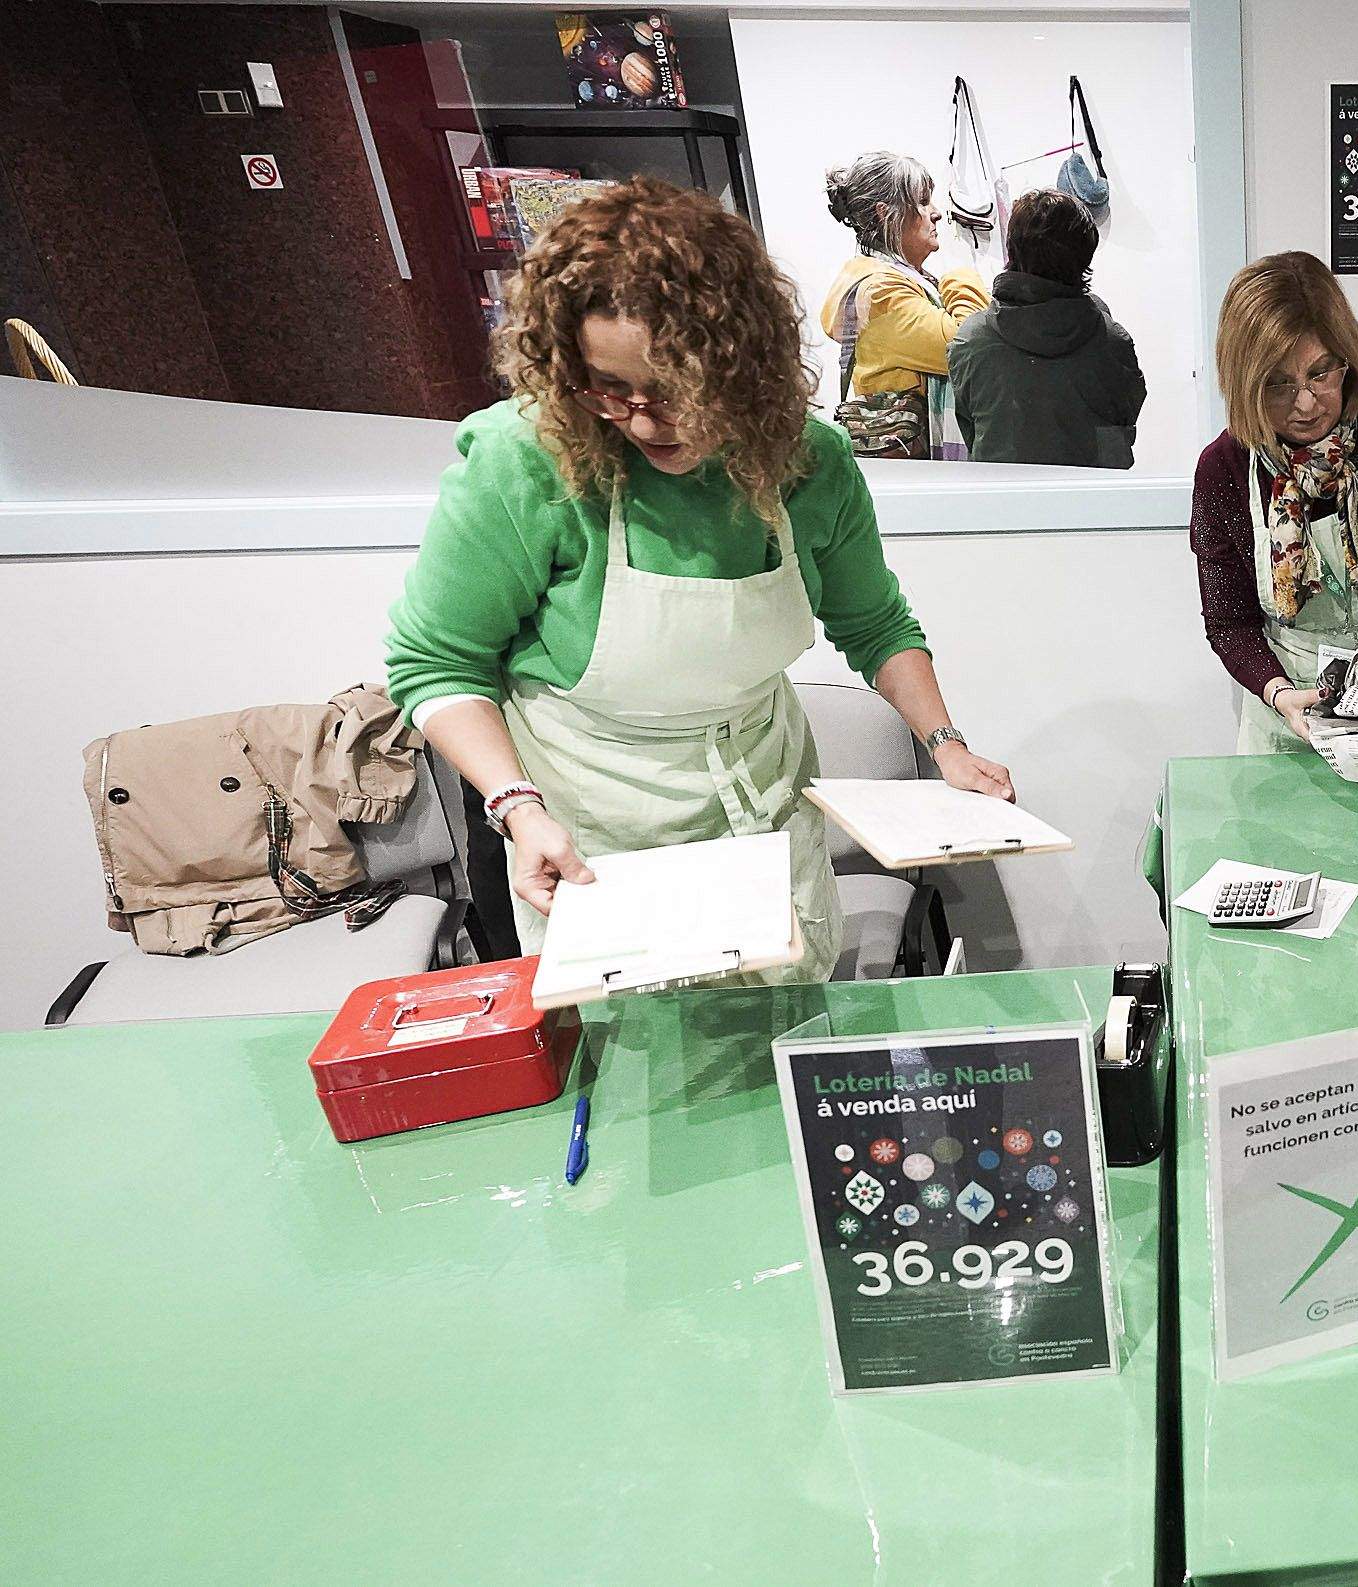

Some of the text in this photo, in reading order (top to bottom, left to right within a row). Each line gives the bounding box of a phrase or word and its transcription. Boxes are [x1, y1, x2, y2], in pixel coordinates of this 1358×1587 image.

[652, 31, 669, 64] 1000
[1338, 108, 1346, 120] á
[914, 1067, 949, 1089] de
[954, 1062, 1033, 1086] Nadal
[816, 1088, 977, 1118] á venda aquí
[1230, 1102, 1256, 1119] No
[1260, 1099, 1280, 1112] se
[1284, 1083, 1354, 1108] aceptan
[1245, 1117, 1292, 1137] salvo
[1296, 1112, 1317, 1125] en
[1243, 1130, 1329, 1158] funcionen
[851, 1237, 1074, 1297] 36.929
